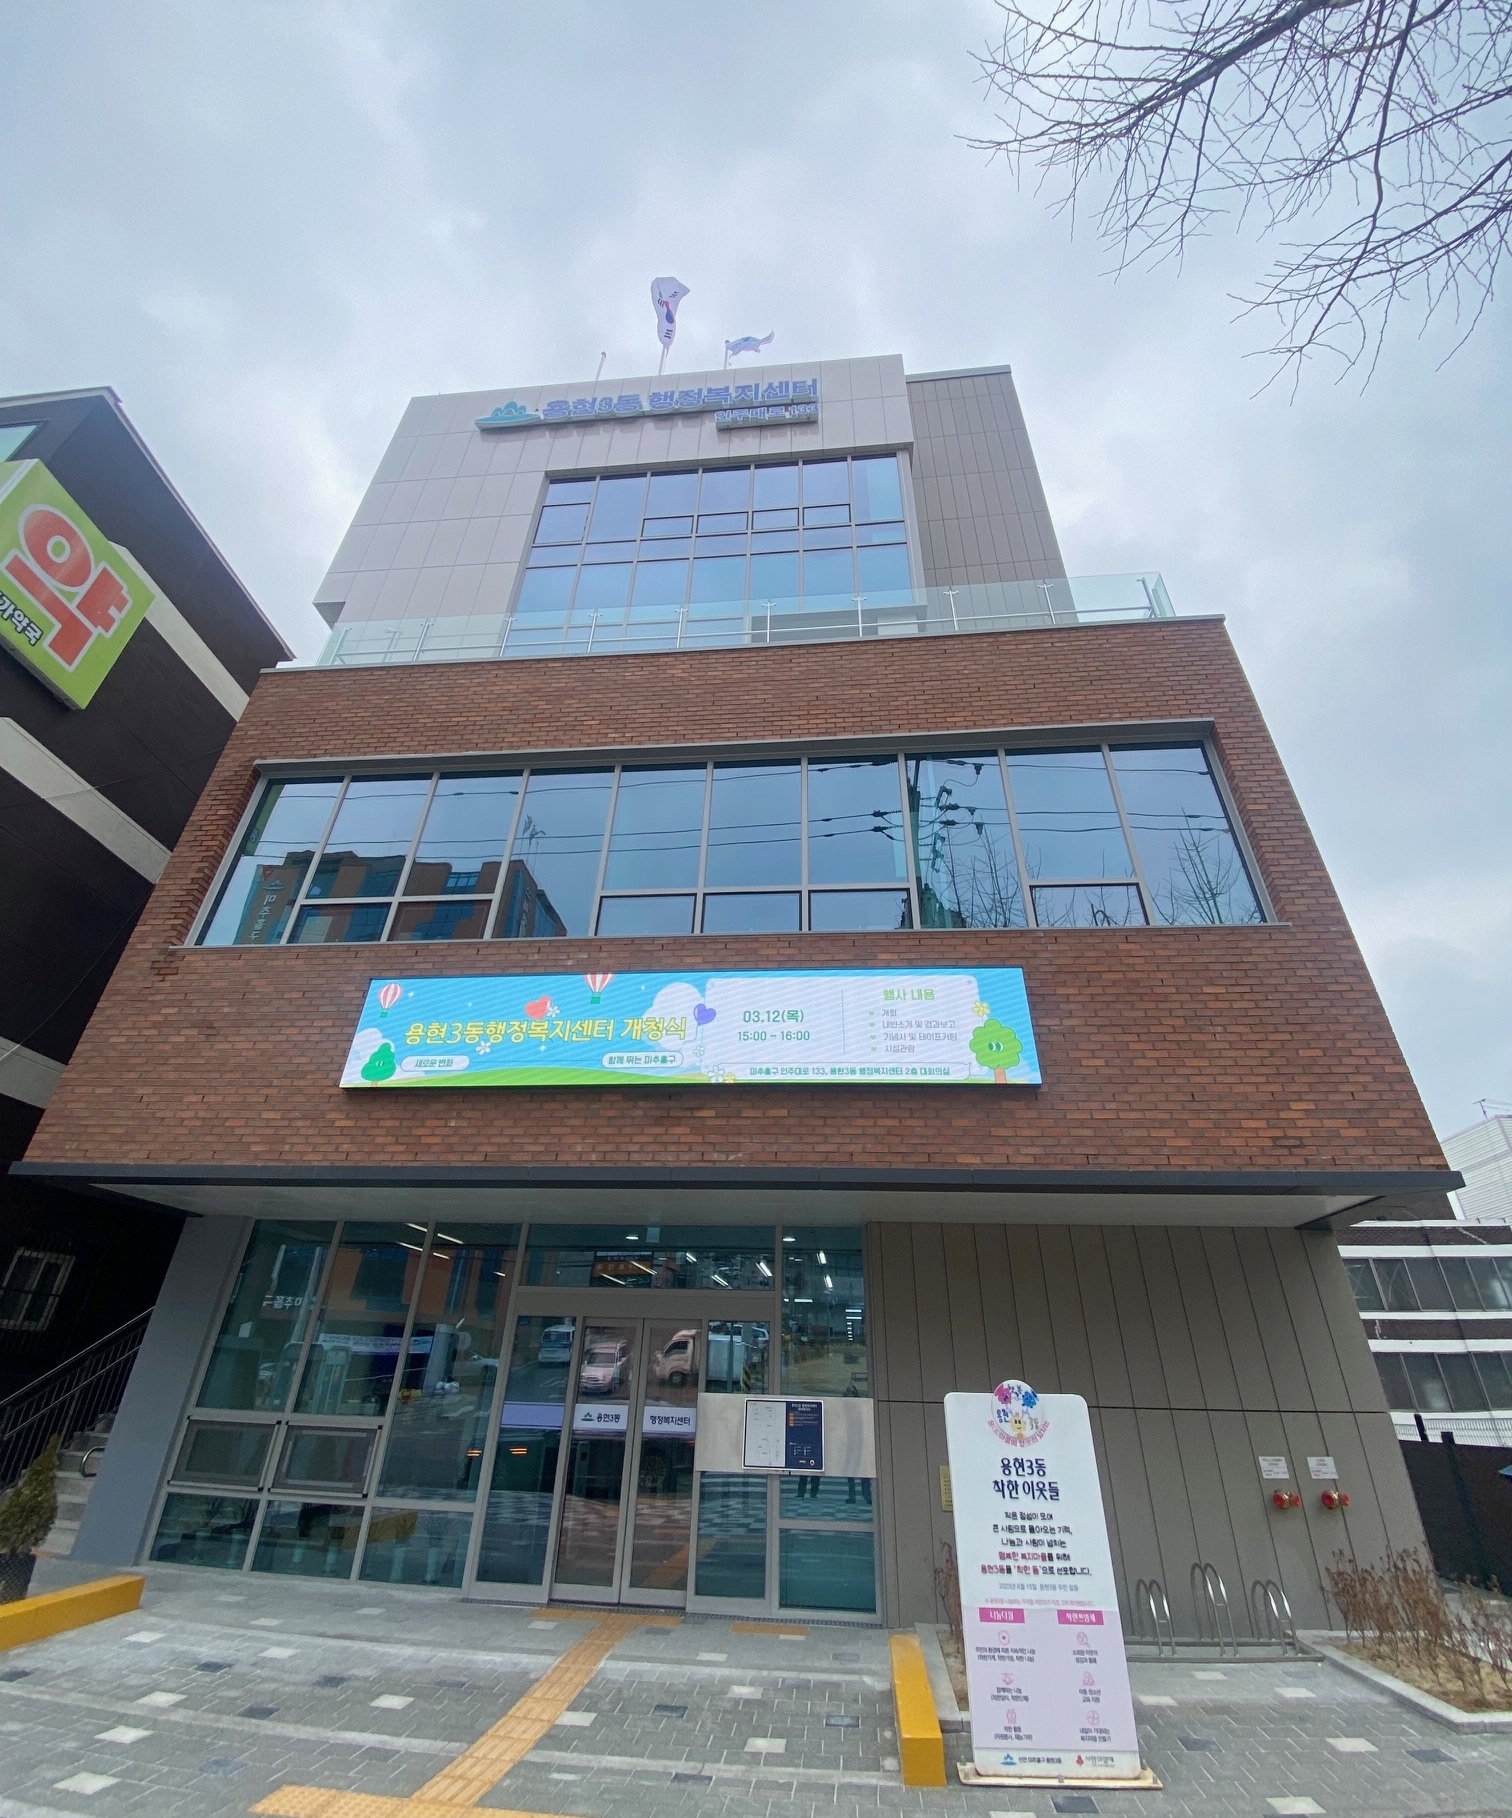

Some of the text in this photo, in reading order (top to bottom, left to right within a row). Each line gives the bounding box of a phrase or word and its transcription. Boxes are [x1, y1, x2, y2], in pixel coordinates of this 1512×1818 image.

[541, 379, 818, 420] 용현3동 행정복지센터
[714, 405, 786, 422] 인주대로
[1, 503, 132, 672] 약
[0, 590, 43, 646] 가약국
[883, 989, 935, 1001] 행사 내용
[743, 1010, 804, 1023] 03.12(목)
[882, 1009, 897, 1017] 개회
[404, 1017, 687, 1045] 용현3동행정복지센터 개청식
[882, 1021, 956, 1029] 내빈소개 및 경과보고
[738, 1031, 767, 1041] 15:00
[780, 1031, 810, 1041] 16:00
[883, 1033, 957, 1042] 기념사 및 테이프커팅
[885, 1045, 915, 1054] 시설관람
[414, 1058, 454, 1068] 새로운 변화
[608, 1055, 676, 1065] 함께 뛰는 미추홀구
[750, 1067, 950, 1077] 미추홀구 인주대로 133, 용현3동 행정복지센터 2층 대회의실
[596, 1413, 621, 1423] 용현3동
[650, 1414, 691, 1427] 행정복지센터
[1000, 1457, 1047, 1477] 용현3동
[992, 1480, 1060, 1501] 착한 이웃들
